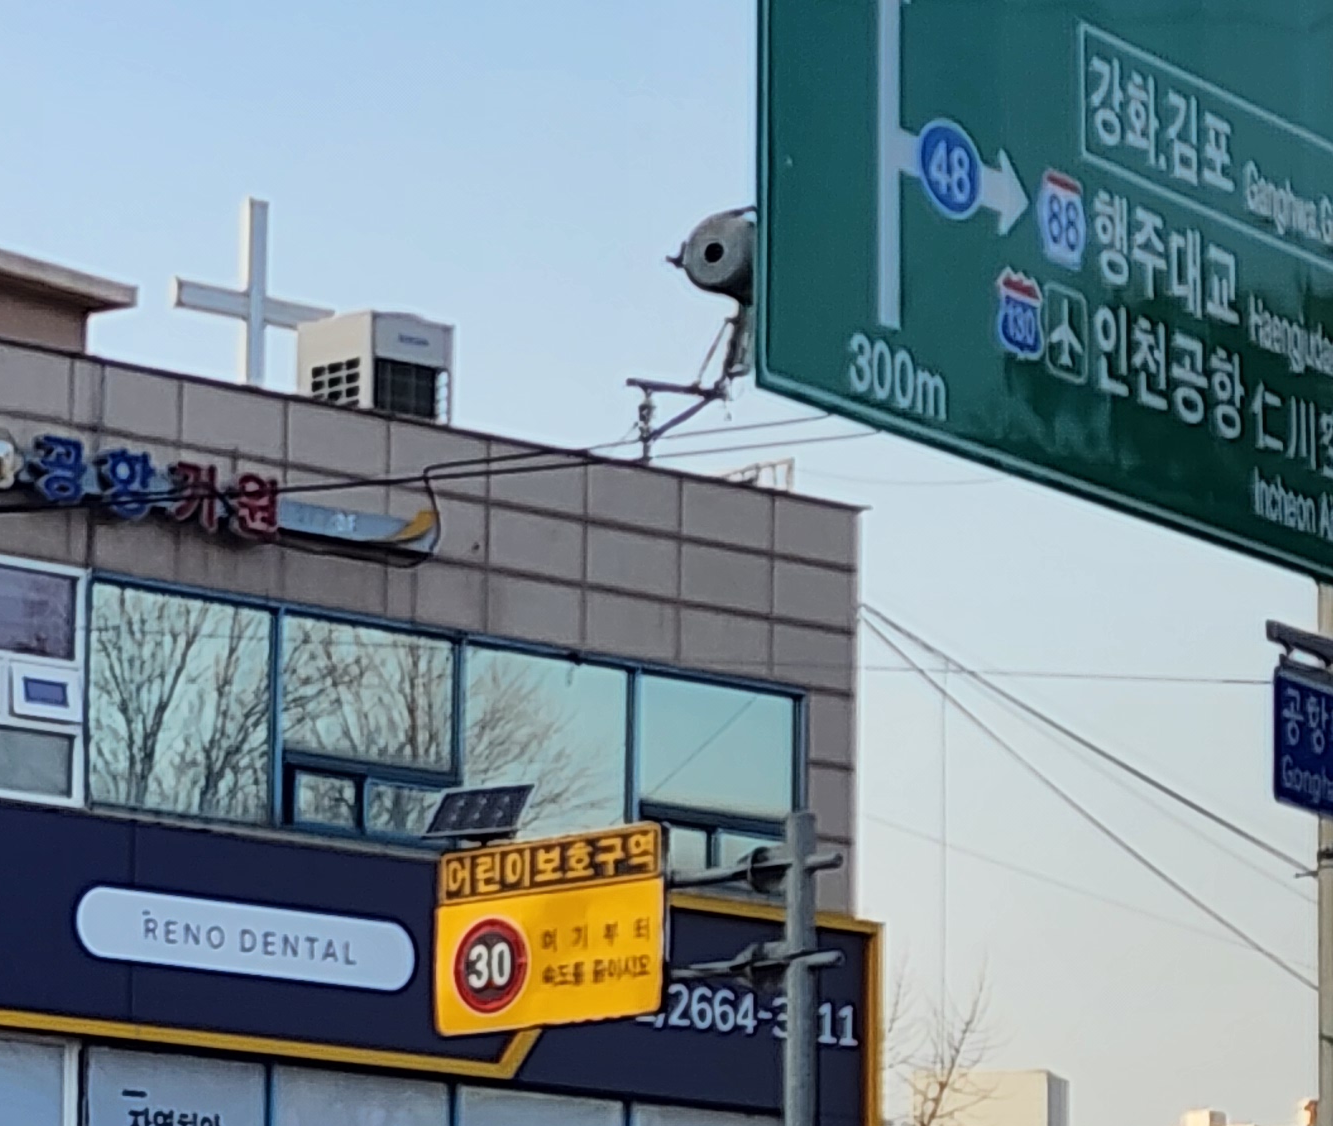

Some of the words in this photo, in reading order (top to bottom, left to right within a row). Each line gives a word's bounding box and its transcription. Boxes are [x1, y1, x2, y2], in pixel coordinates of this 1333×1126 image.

[932, 141, 970, 199] 48
[1047, 194, 1080, 251] 88
[1093, 188, 1240, 326] 행주대교
[1006, 302, 1037, 344] 130
[848, 332, 949, 422] 300m
[1095, 303, 1241, 441] 인천공항
[1254, 466, 1316, 534] Incheon
[1283, 686, 1333, 756] 공항
[444, 829, 659, 897] 어린이보호구역
[141, 909, 227, 951] RENO
[239, 926, 359, 968] DENTAL
[467, 943, 513, 988] 30
